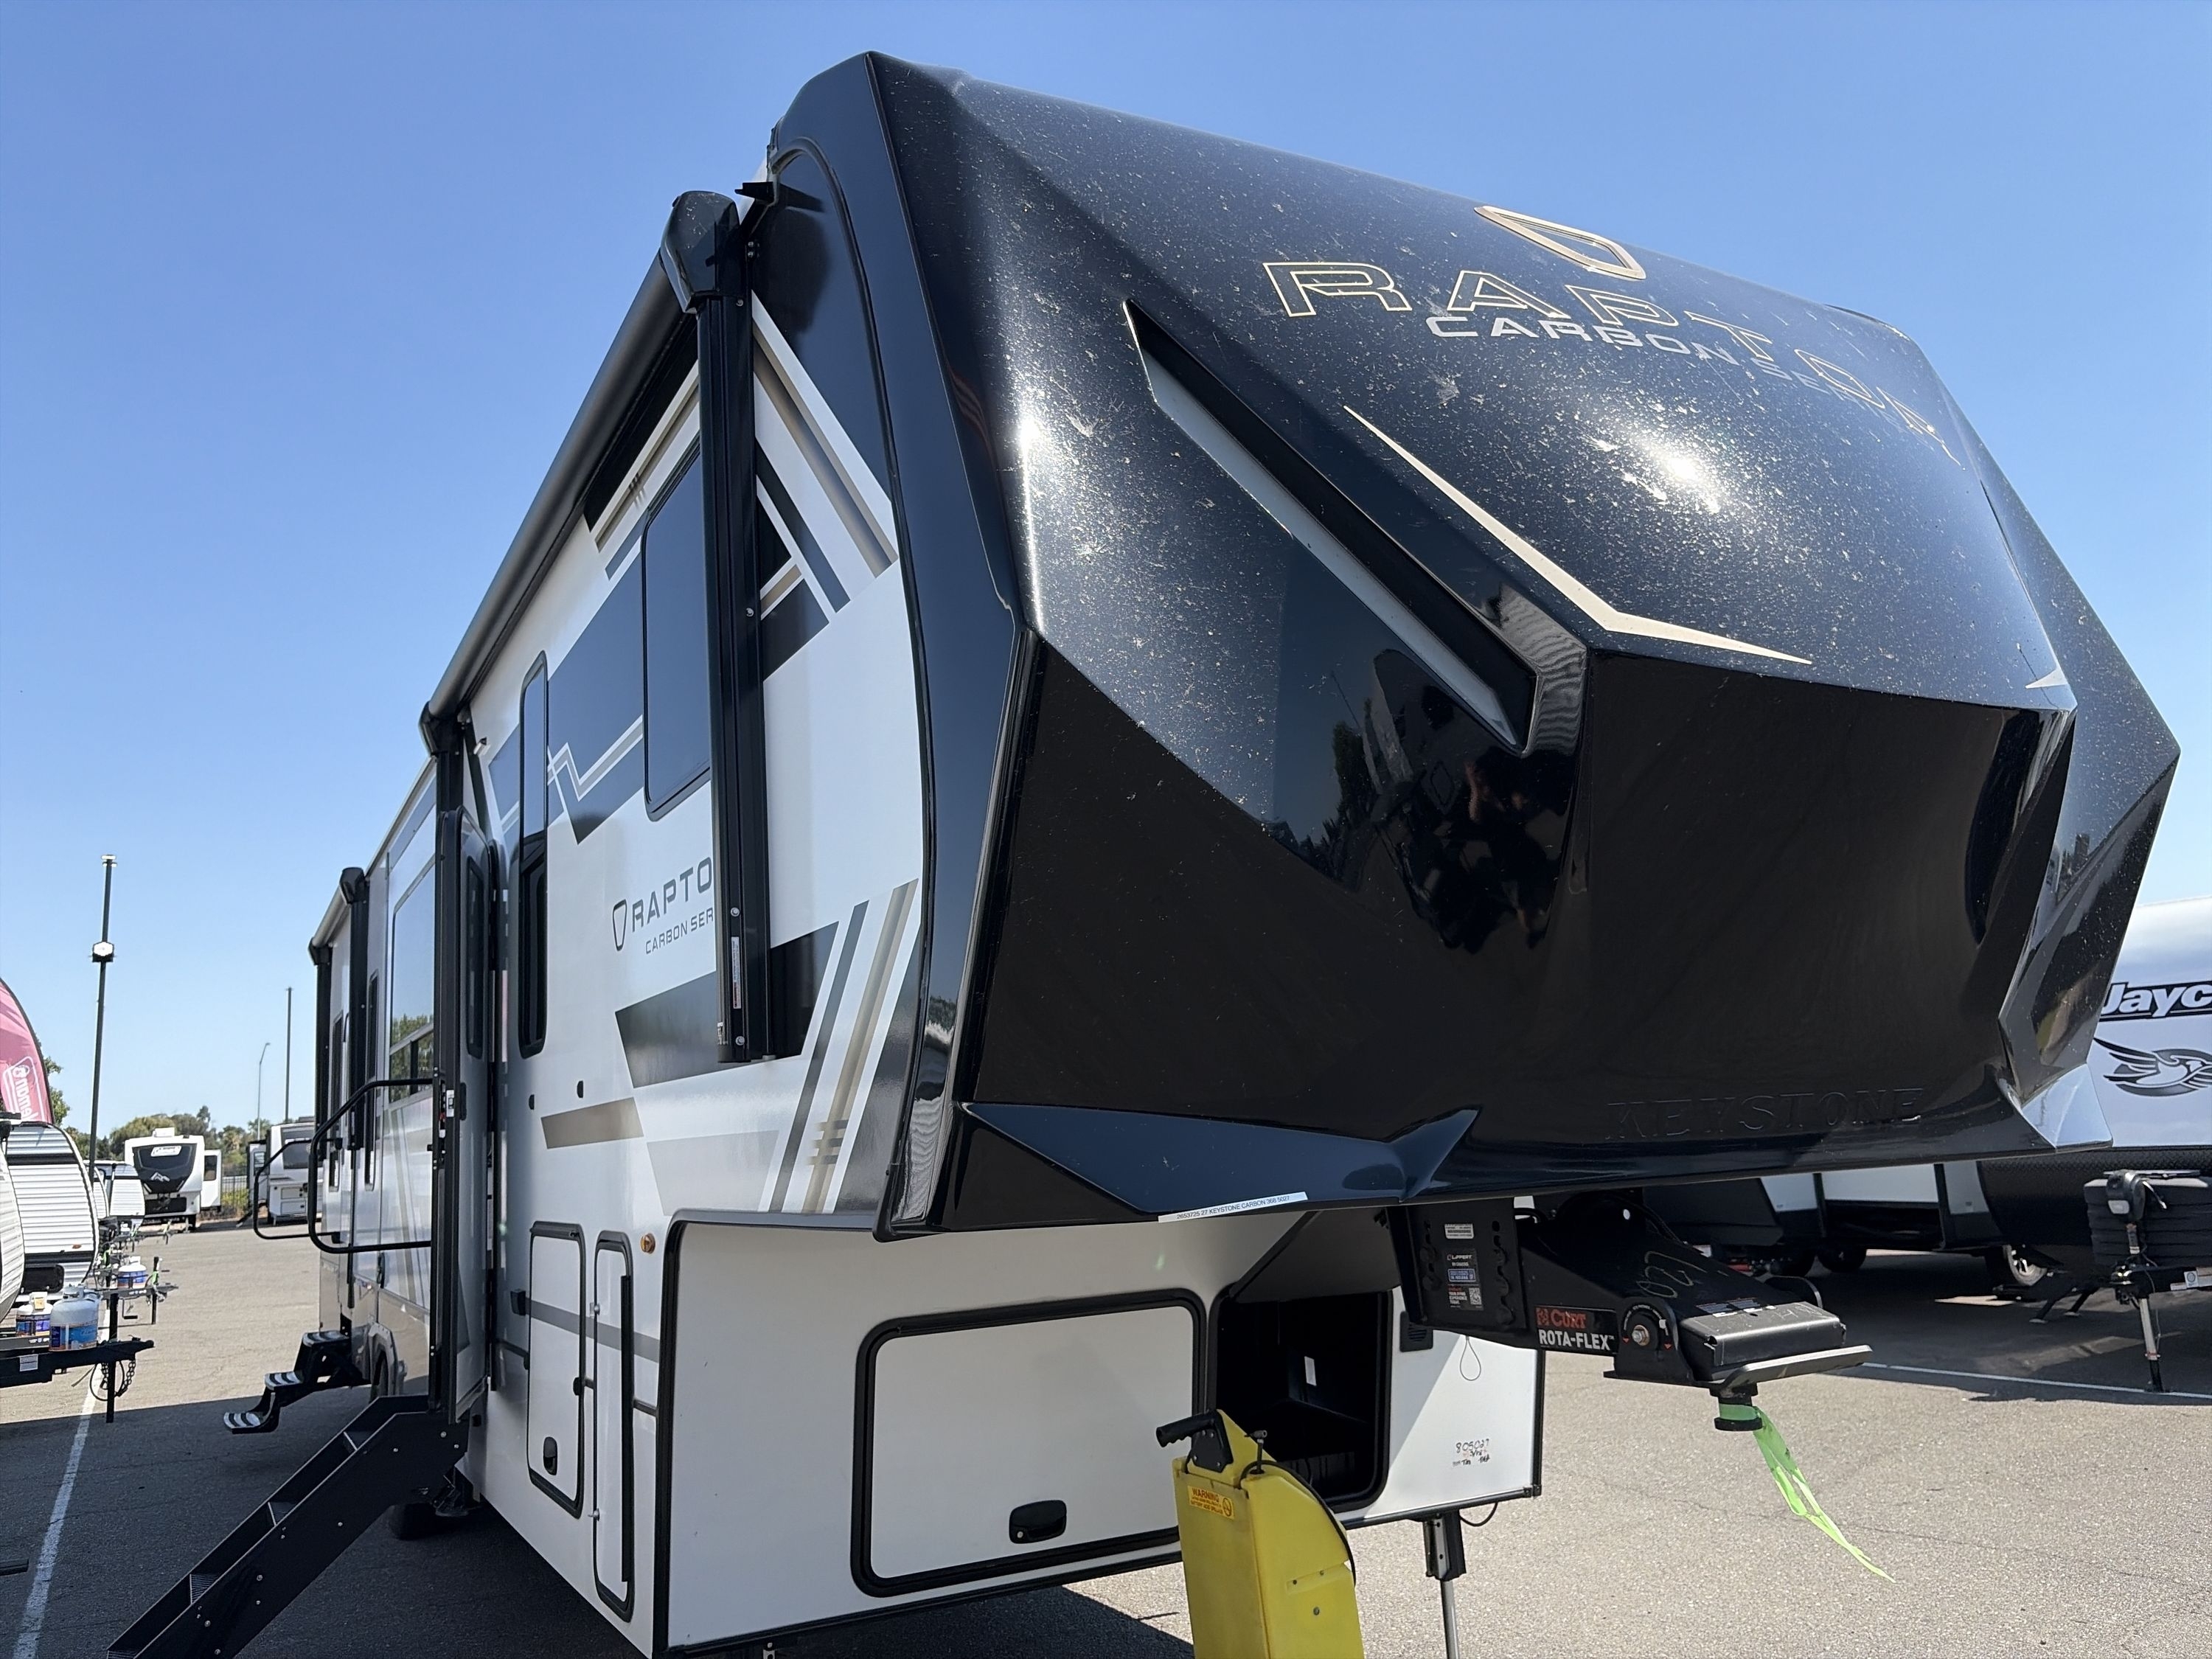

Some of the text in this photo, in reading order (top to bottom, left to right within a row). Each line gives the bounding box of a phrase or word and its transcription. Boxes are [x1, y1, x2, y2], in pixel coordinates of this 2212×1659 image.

[1262, 261, 1961, 467] RAPTOR
[1425, 316, 1740, 366] CARBON
[631, 856, 712, 933] RAPTO
[645, 907, 714, 955] CARBON SER
[2101, 983, 2212, 1018] Jayc
[1604, 1088, 1923, 1139] KEYSTONE
[1208, 1203, 1241, 1214] KEYSTONE
[1241, 1200, 1266, 1209] CARBON
[1192, 1487, 1220, 1503] WARNING
